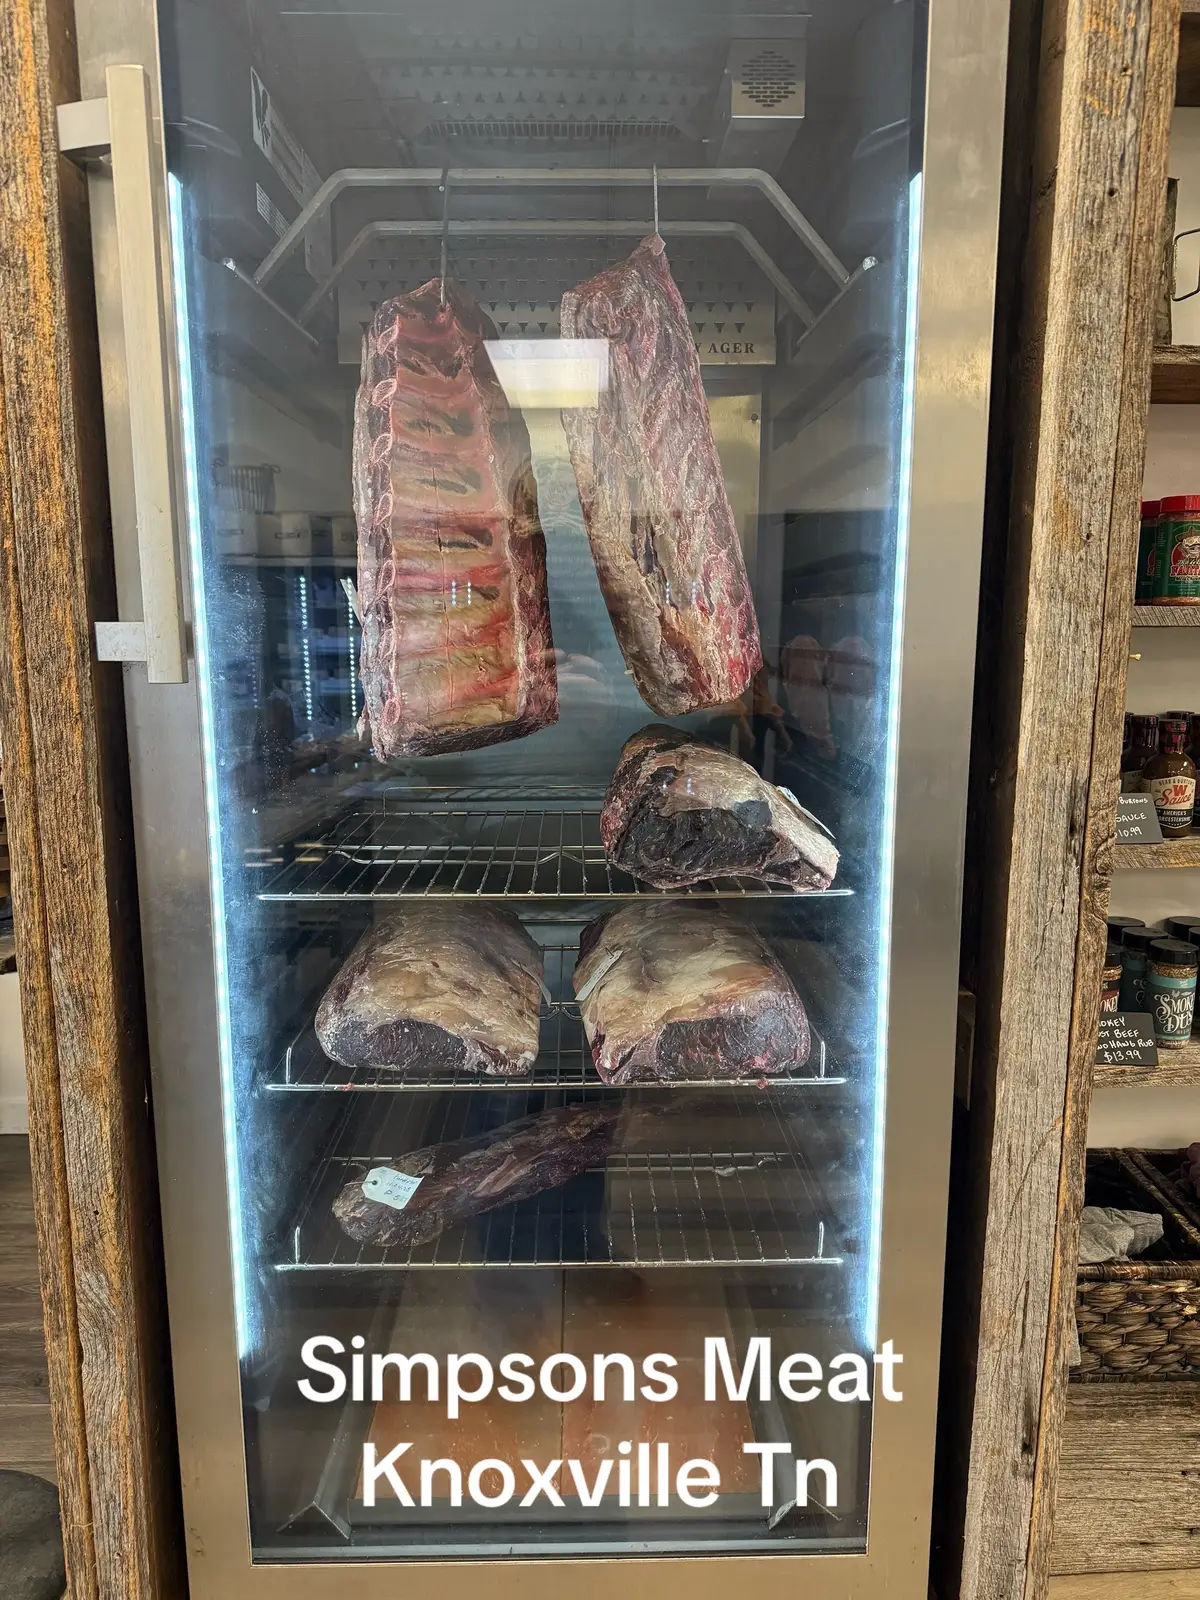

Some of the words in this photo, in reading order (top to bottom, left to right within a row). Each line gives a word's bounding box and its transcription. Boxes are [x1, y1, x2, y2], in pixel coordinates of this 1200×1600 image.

[708, 342, 755, 354] AGER
[1172, 784, 1188, 797] W
[1154, 788, 1193, 807] Sauce
[1115, 812, 1147, 823] SAUCE
[1099, 1016, 1125, 1027] OKEY
[1113, 1029, 1139, 1038] BEEF
[1104, 1049, 1142, 1063] $13.99
